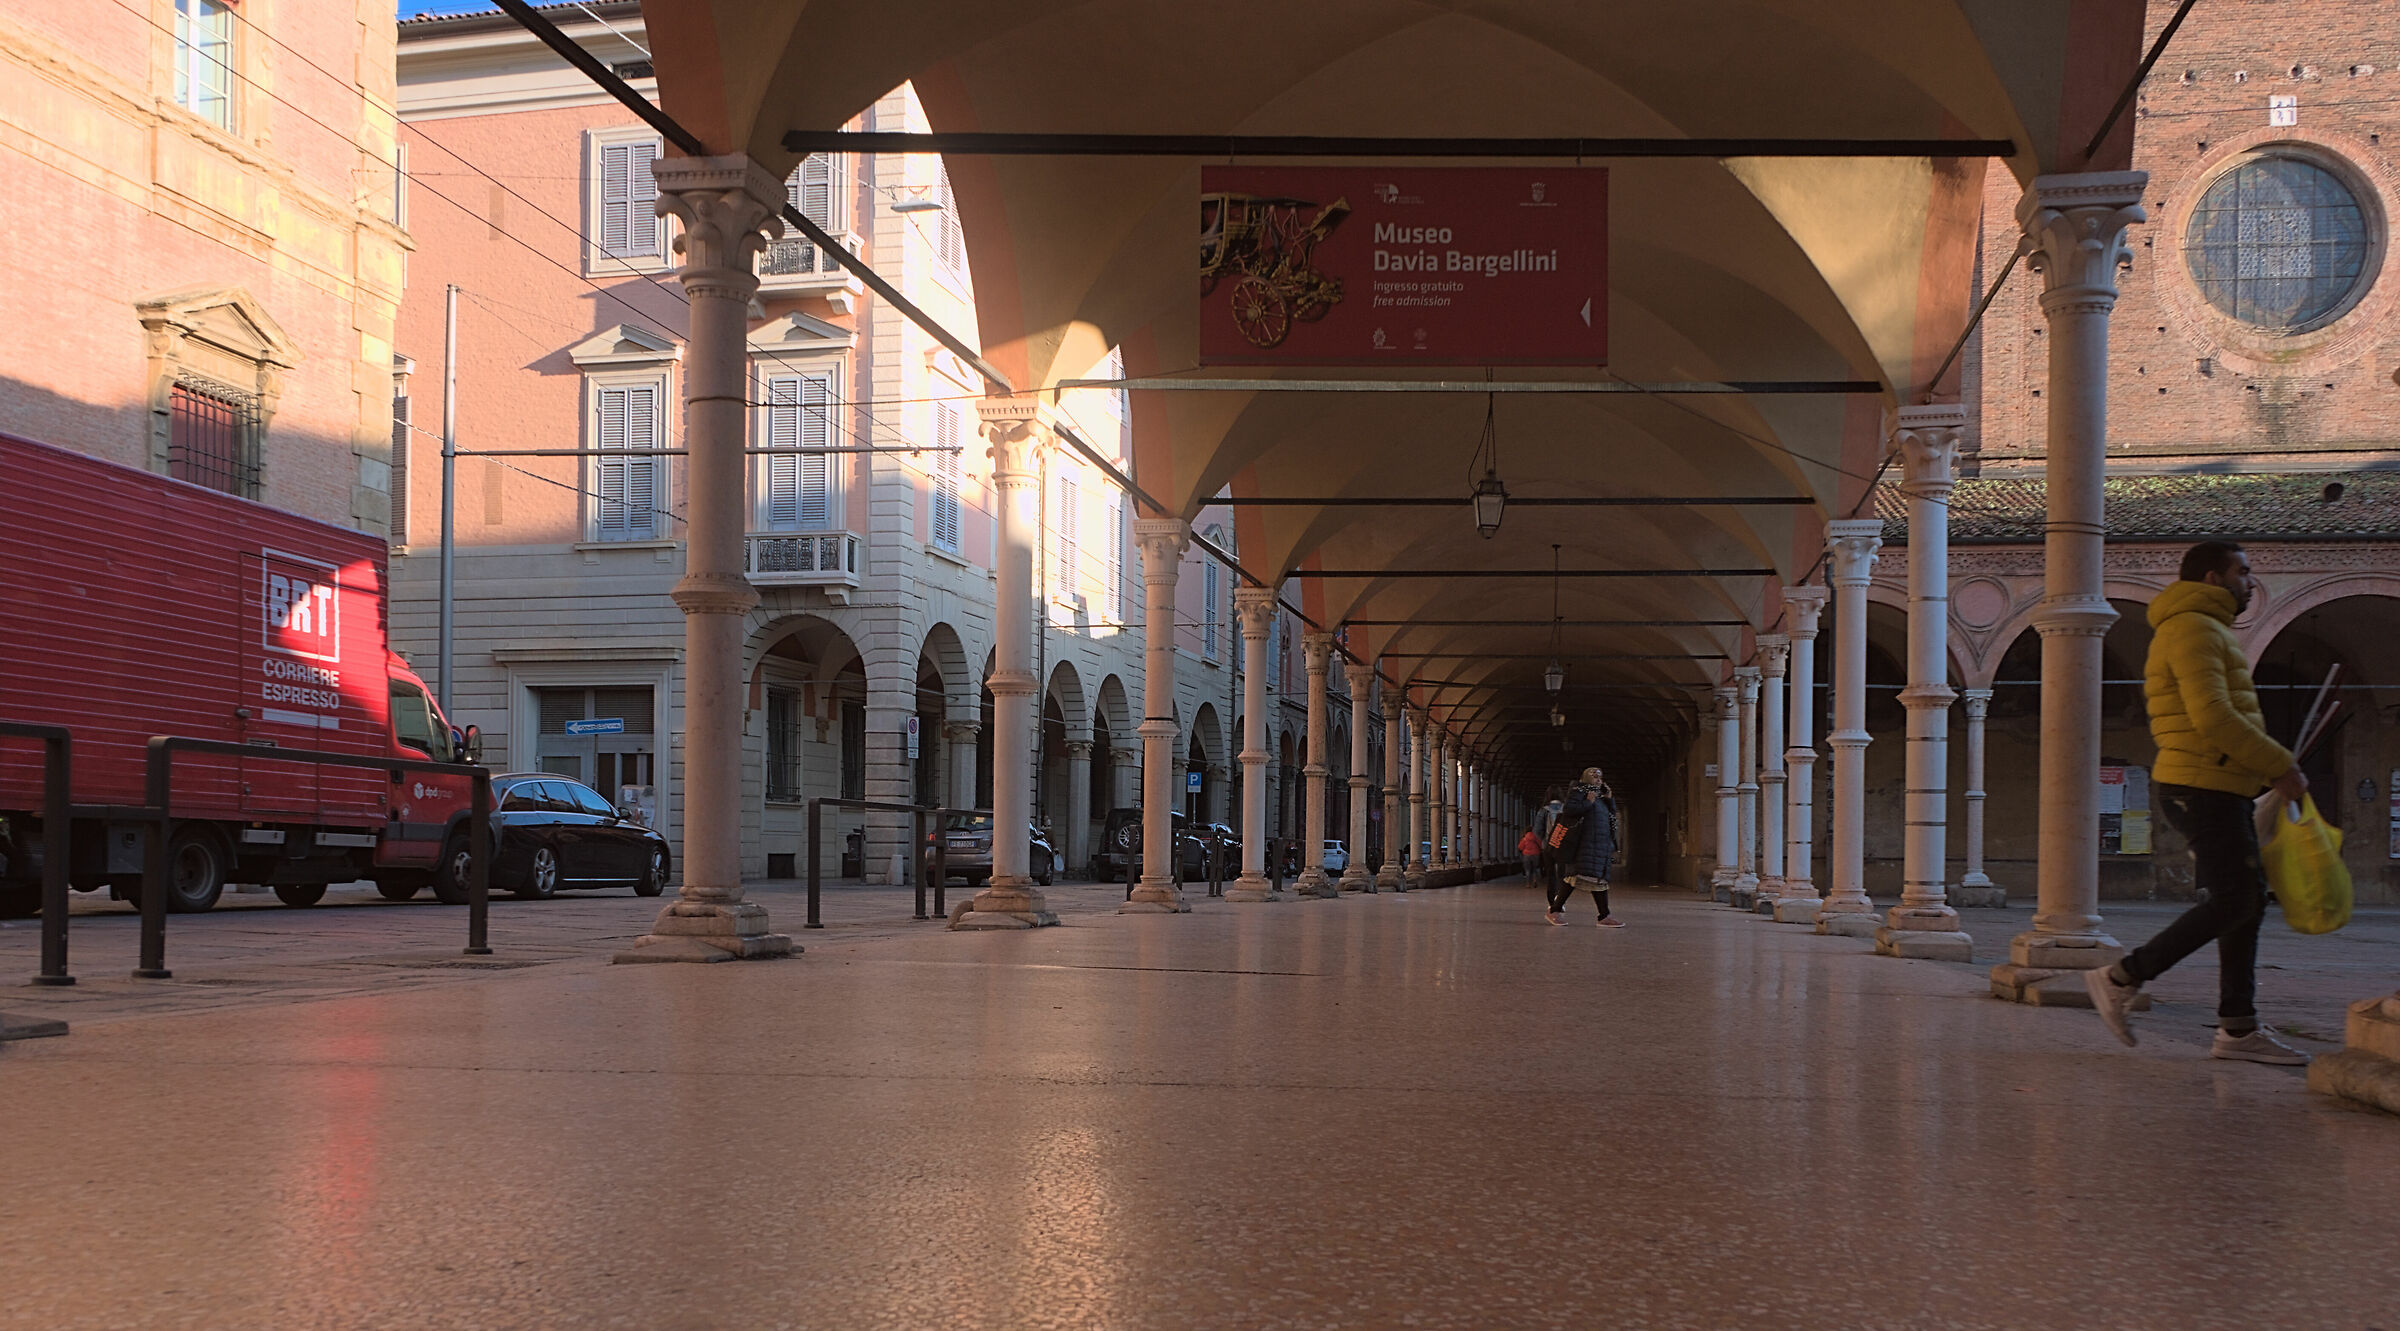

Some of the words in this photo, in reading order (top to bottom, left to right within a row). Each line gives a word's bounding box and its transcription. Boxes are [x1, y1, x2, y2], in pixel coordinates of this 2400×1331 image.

[1374, 222, 1452, 244] Museo
[1374, 250, 1438, 272] Davia
[1446, 250, 1557, 277] Bargellini
[1373, 281, 1418, 294] ingresso
[1420, 281, 1464, 294] gratuito
[1373, 295, 1394, 308] free
[1396, 295, 1451, 307] admission
[270, 574, 332, 637] BRT
[263, 659, 340, 687] CORRIERE
[263, 682, 340, 709] ESPRESSO
[1190, 774, 1199, 785] P
